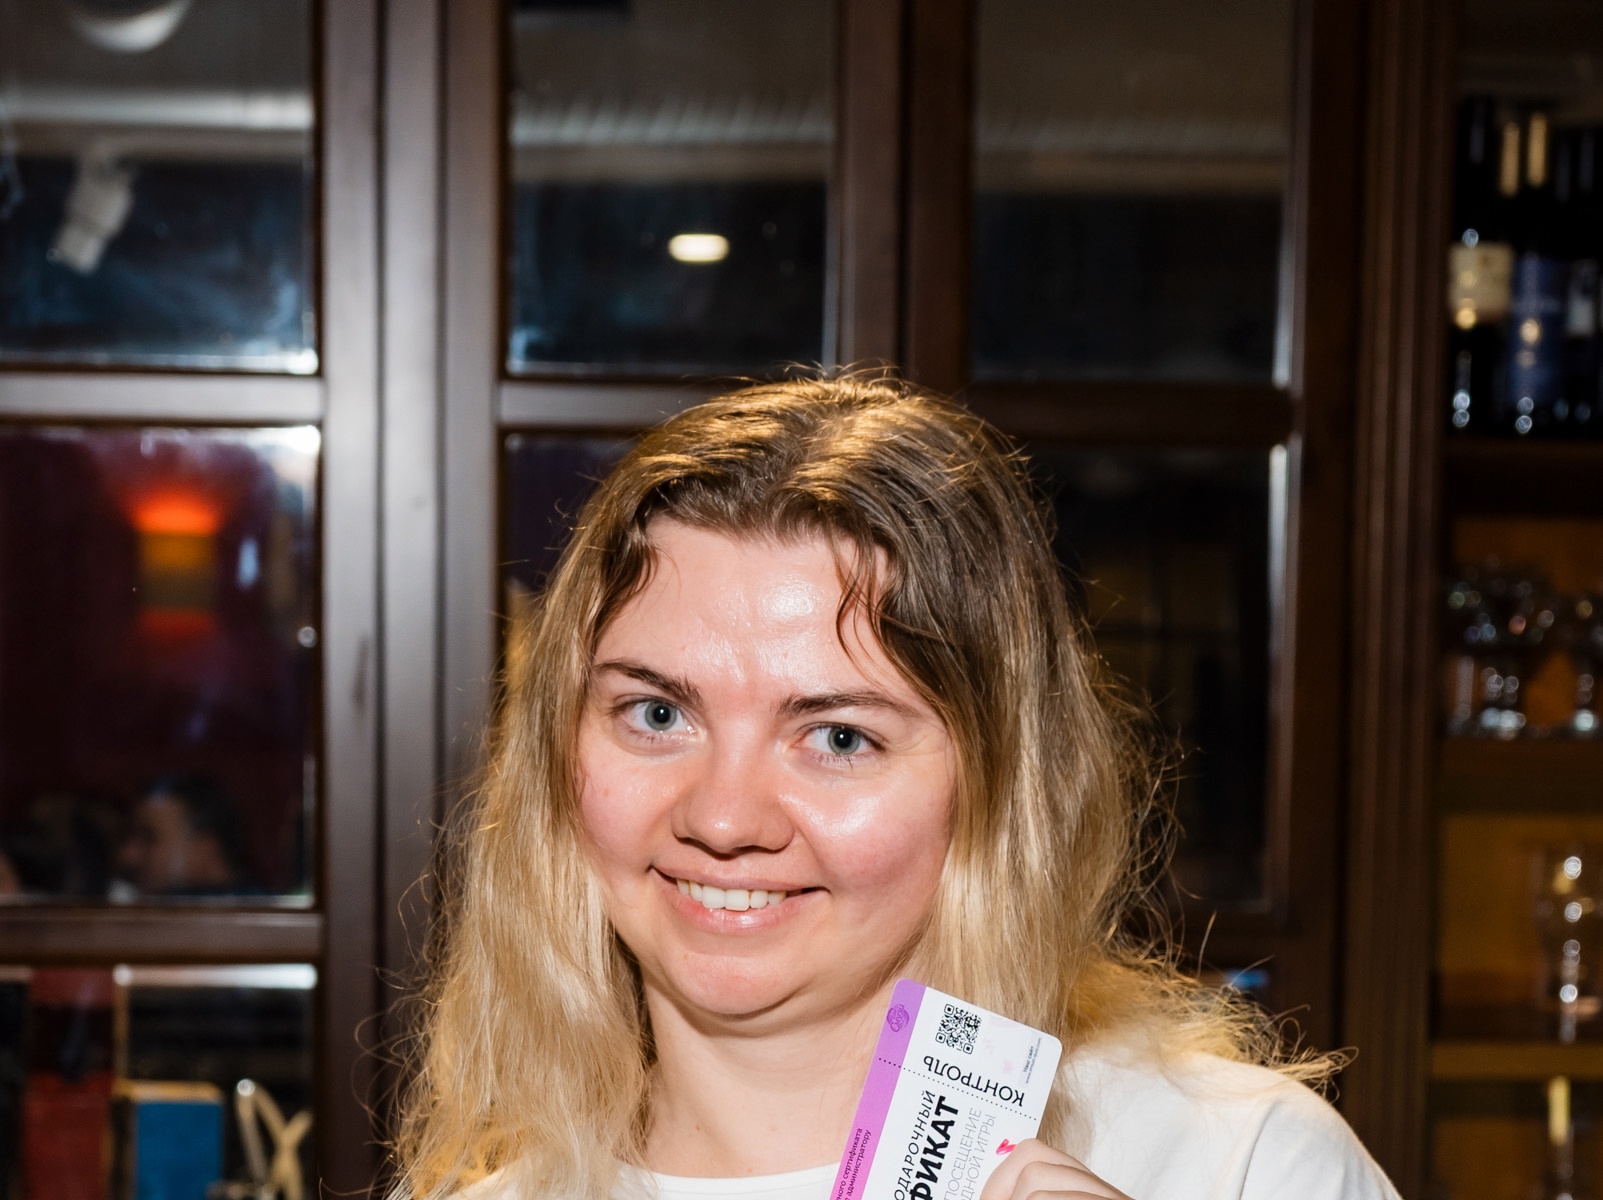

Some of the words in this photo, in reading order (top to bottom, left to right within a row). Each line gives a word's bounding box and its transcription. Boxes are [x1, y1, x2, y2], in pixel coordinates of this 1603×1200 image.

[923, 1055, 1025, 1108] КОНТРОЛЬ
[842, 1128, 863, 1180] сертификата
[973, 1113, 997, 1154] ИГРЫ
[845, 1129, 872, 1197] администратору
